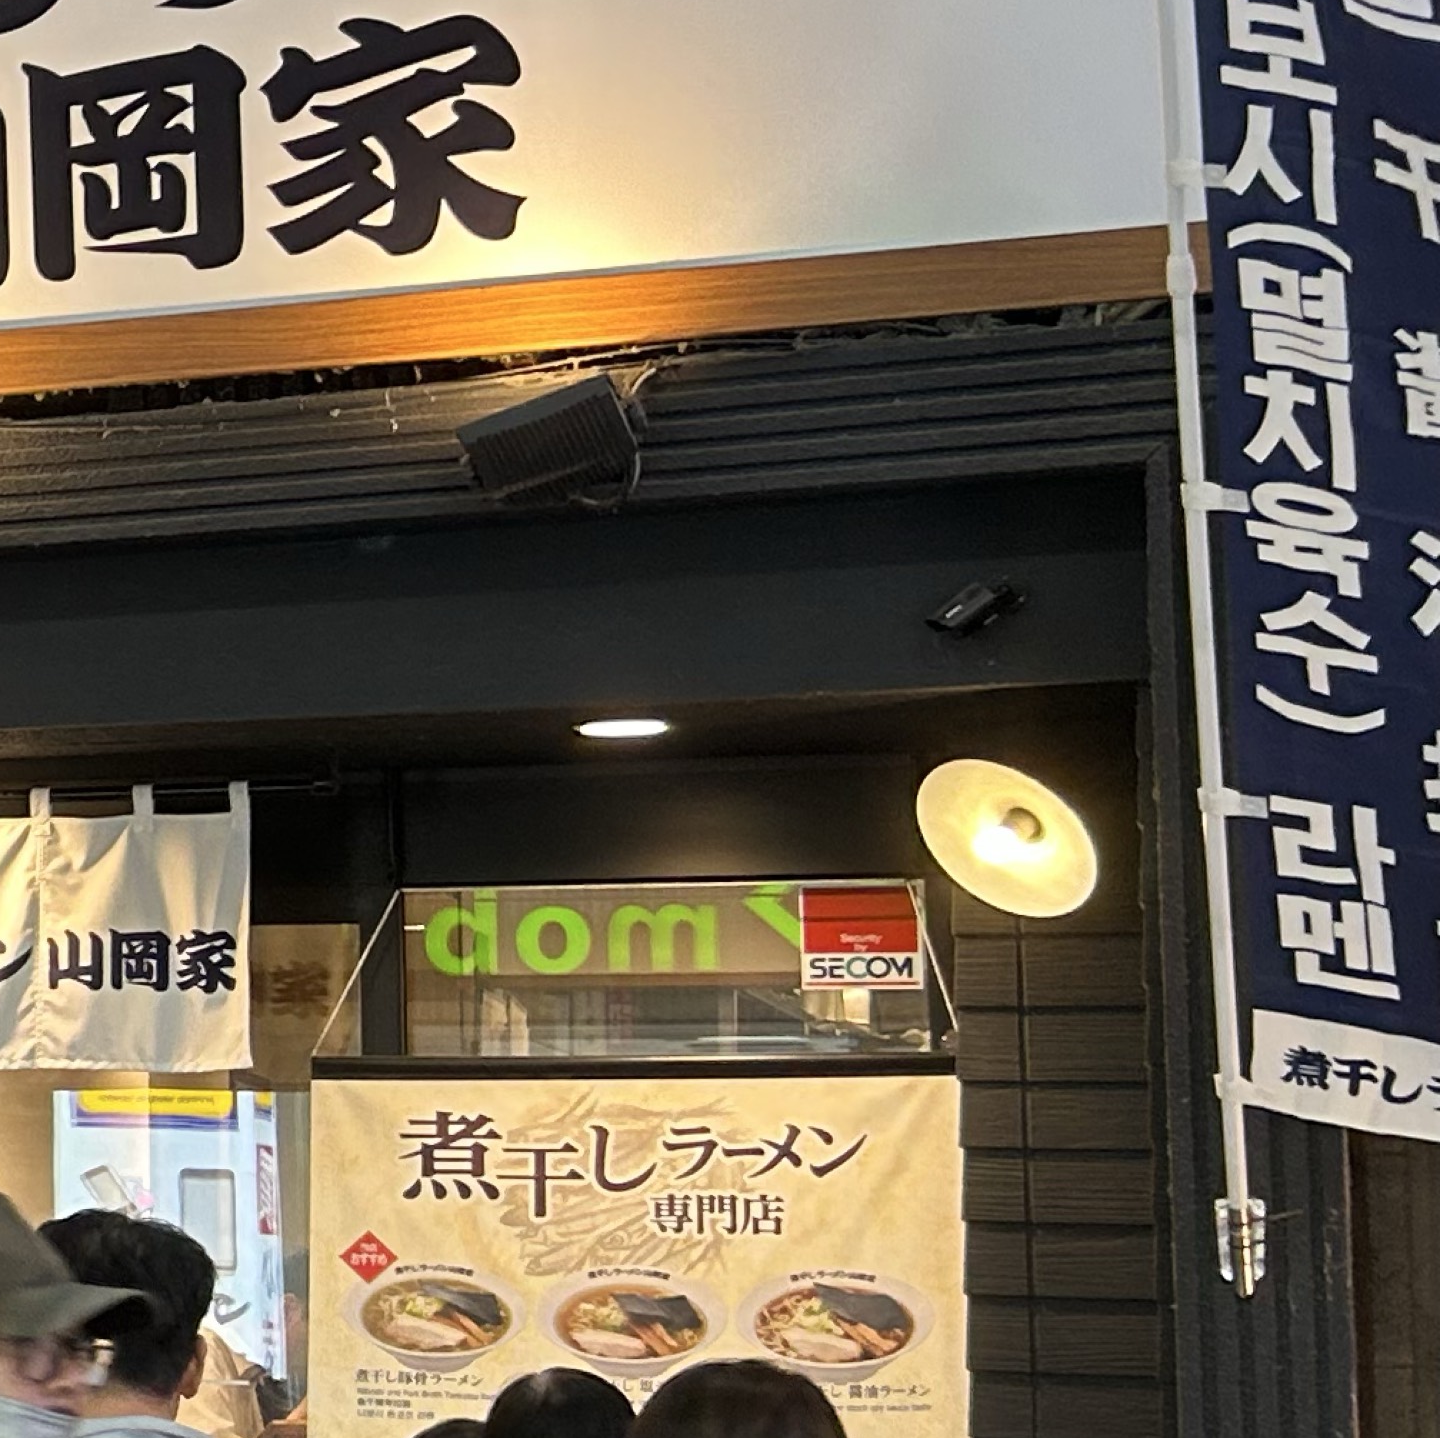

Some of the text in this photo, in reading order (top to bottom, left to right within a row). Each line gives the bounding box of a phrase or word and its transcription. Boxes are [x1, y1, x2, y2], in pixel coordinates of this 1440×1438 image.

[1269, 794, 1402, 1002] 라멘
[808, 955, 914, 980] SECOM
[398, 1111, 869, 1220] 煮干しラーメン
[648, 1192, 786, 1238] 専門店
